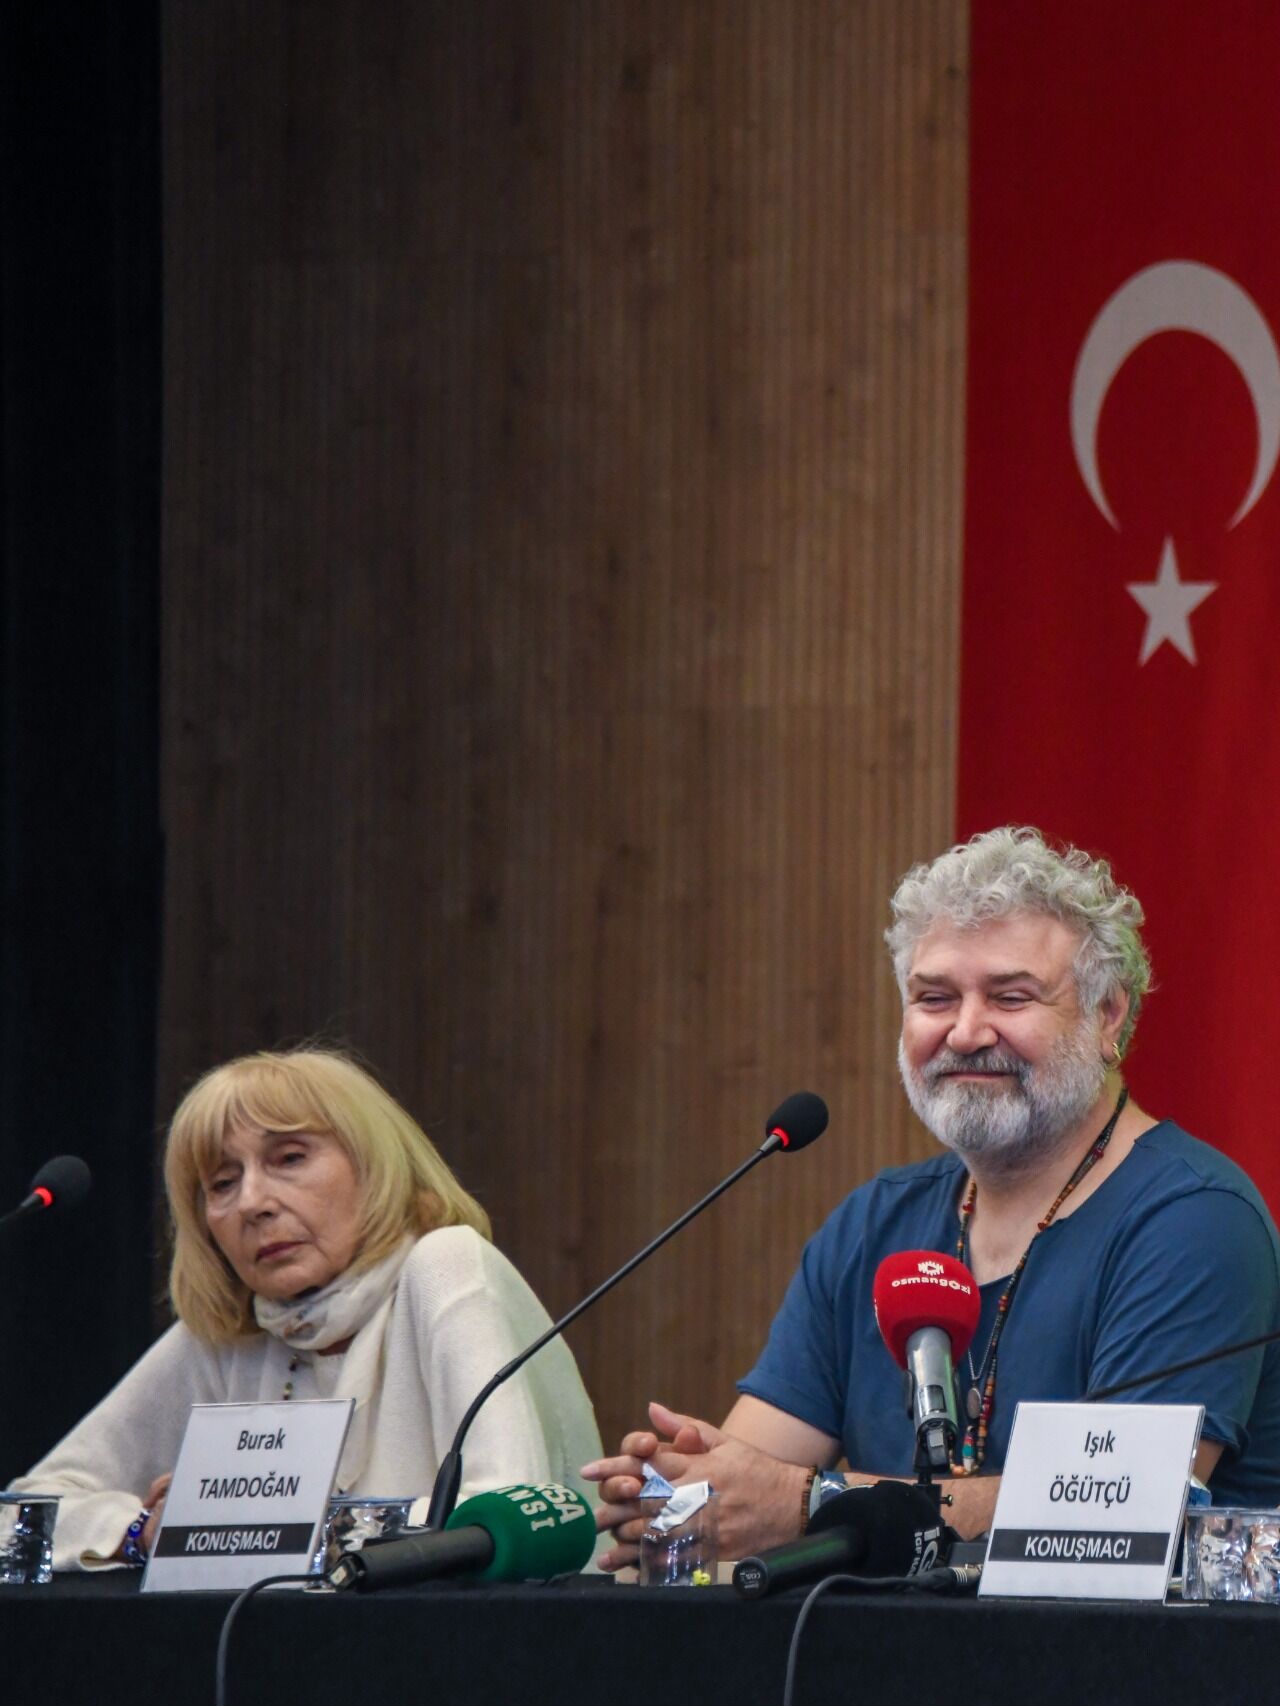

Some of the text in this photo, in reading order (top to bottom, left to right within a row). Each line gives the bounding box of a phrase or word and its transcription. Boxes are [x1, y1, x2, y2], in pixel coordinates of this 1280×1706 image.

[236, 1427, 286, 1451] Burak
[1084, 1430, 1116, 1458] Işık
[199, 1471, 300, 1499] TAMDOĞAN
[1049, 1474, 1131, 1508] ÖĞÜTÇÜ
[185, 1529, 281, 1554] KONUŞMACI
[1024, 1535, 1132, 1562] KONUŞMACI
